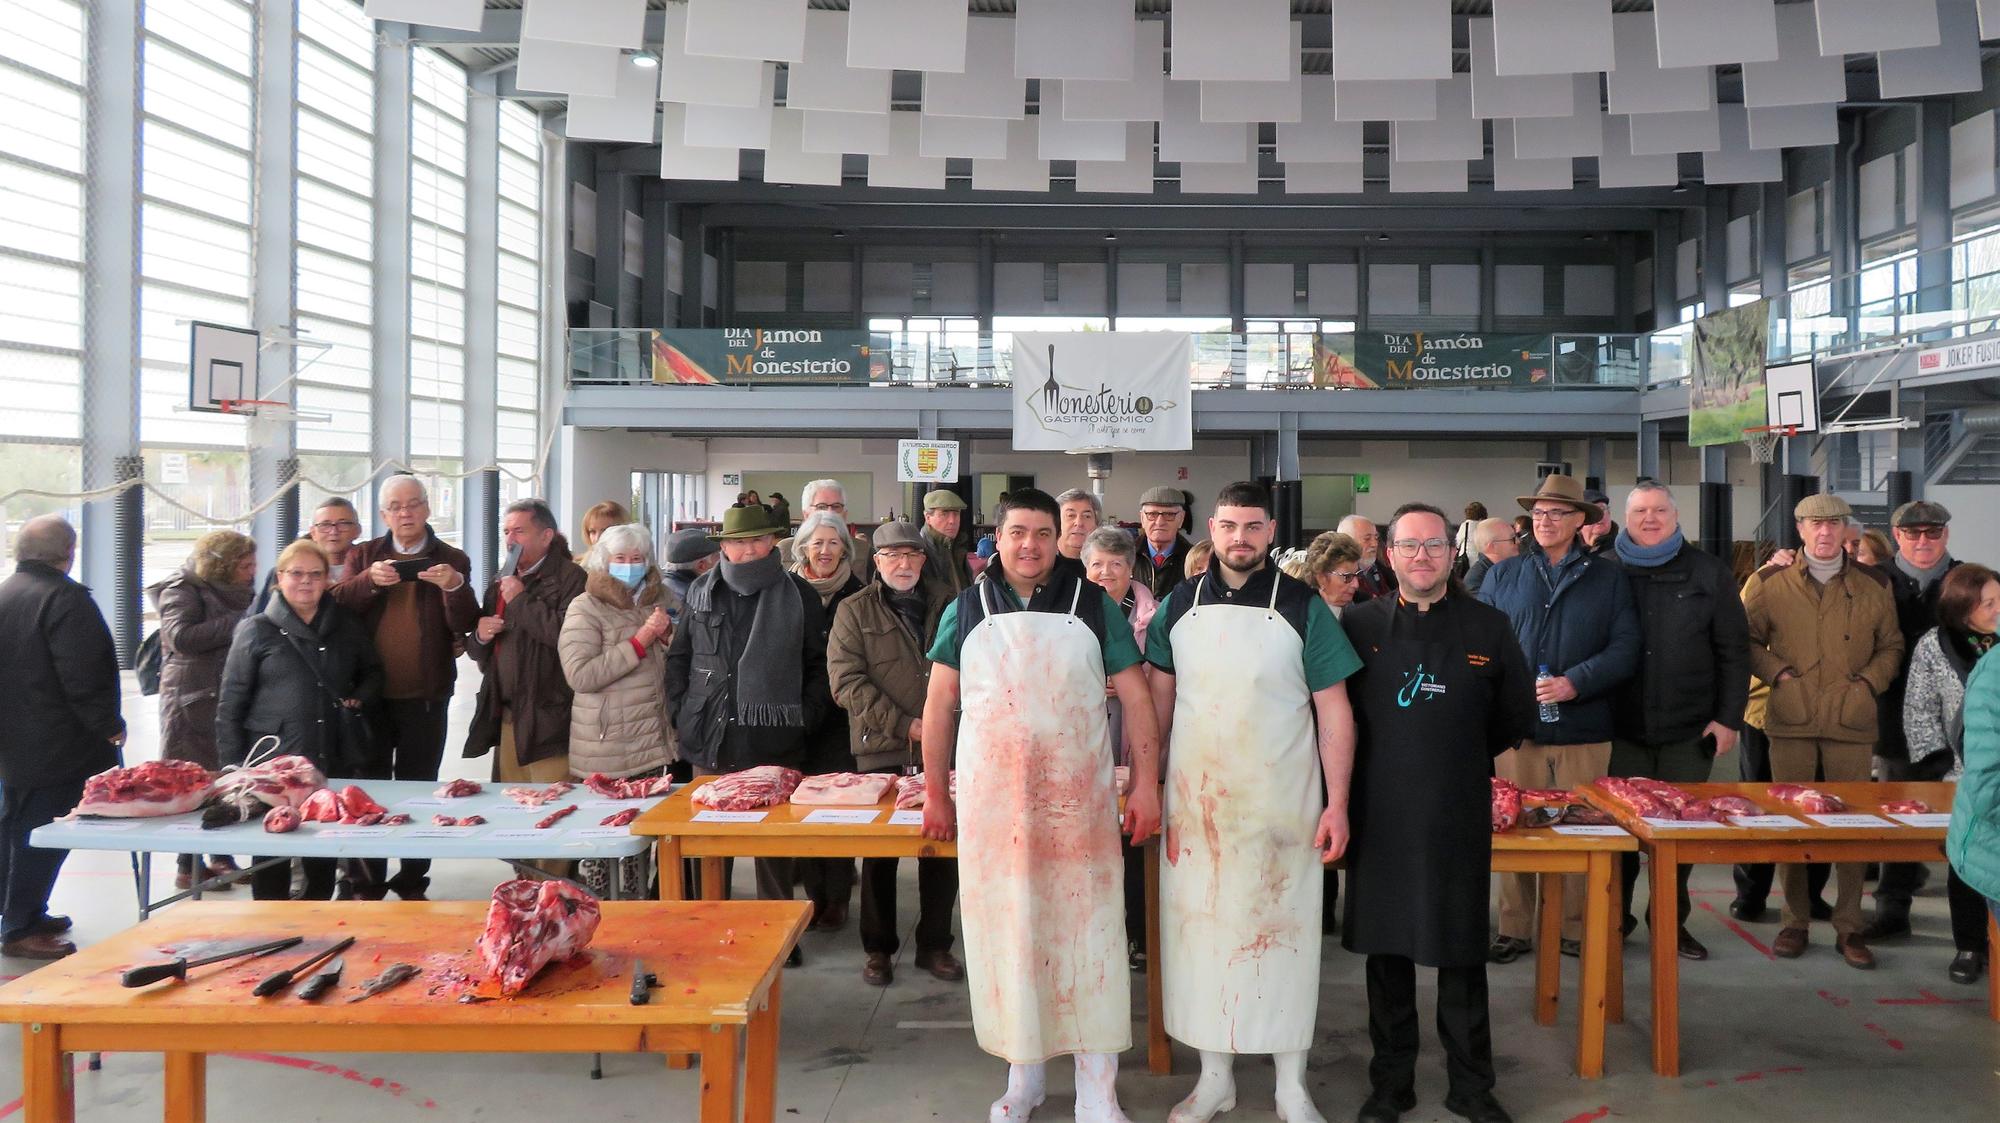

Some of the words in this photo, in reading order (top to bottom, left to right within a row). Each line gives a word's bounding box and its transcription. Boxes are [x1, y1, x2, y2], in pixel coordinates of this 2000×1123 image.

[729, 339, 748, 348] DEL
[1389, 346, 1409, 354] DEL
[1414, 330, 1484, 357] Jamón
[761, 347, 776, 359] de
[1422, 353, 1436, 364] de
[1946, 345, 1974, 368] JOKER
[725, 354, 851, 375] Monesterio
[1386, 360, 1512, 381] Monesterio
